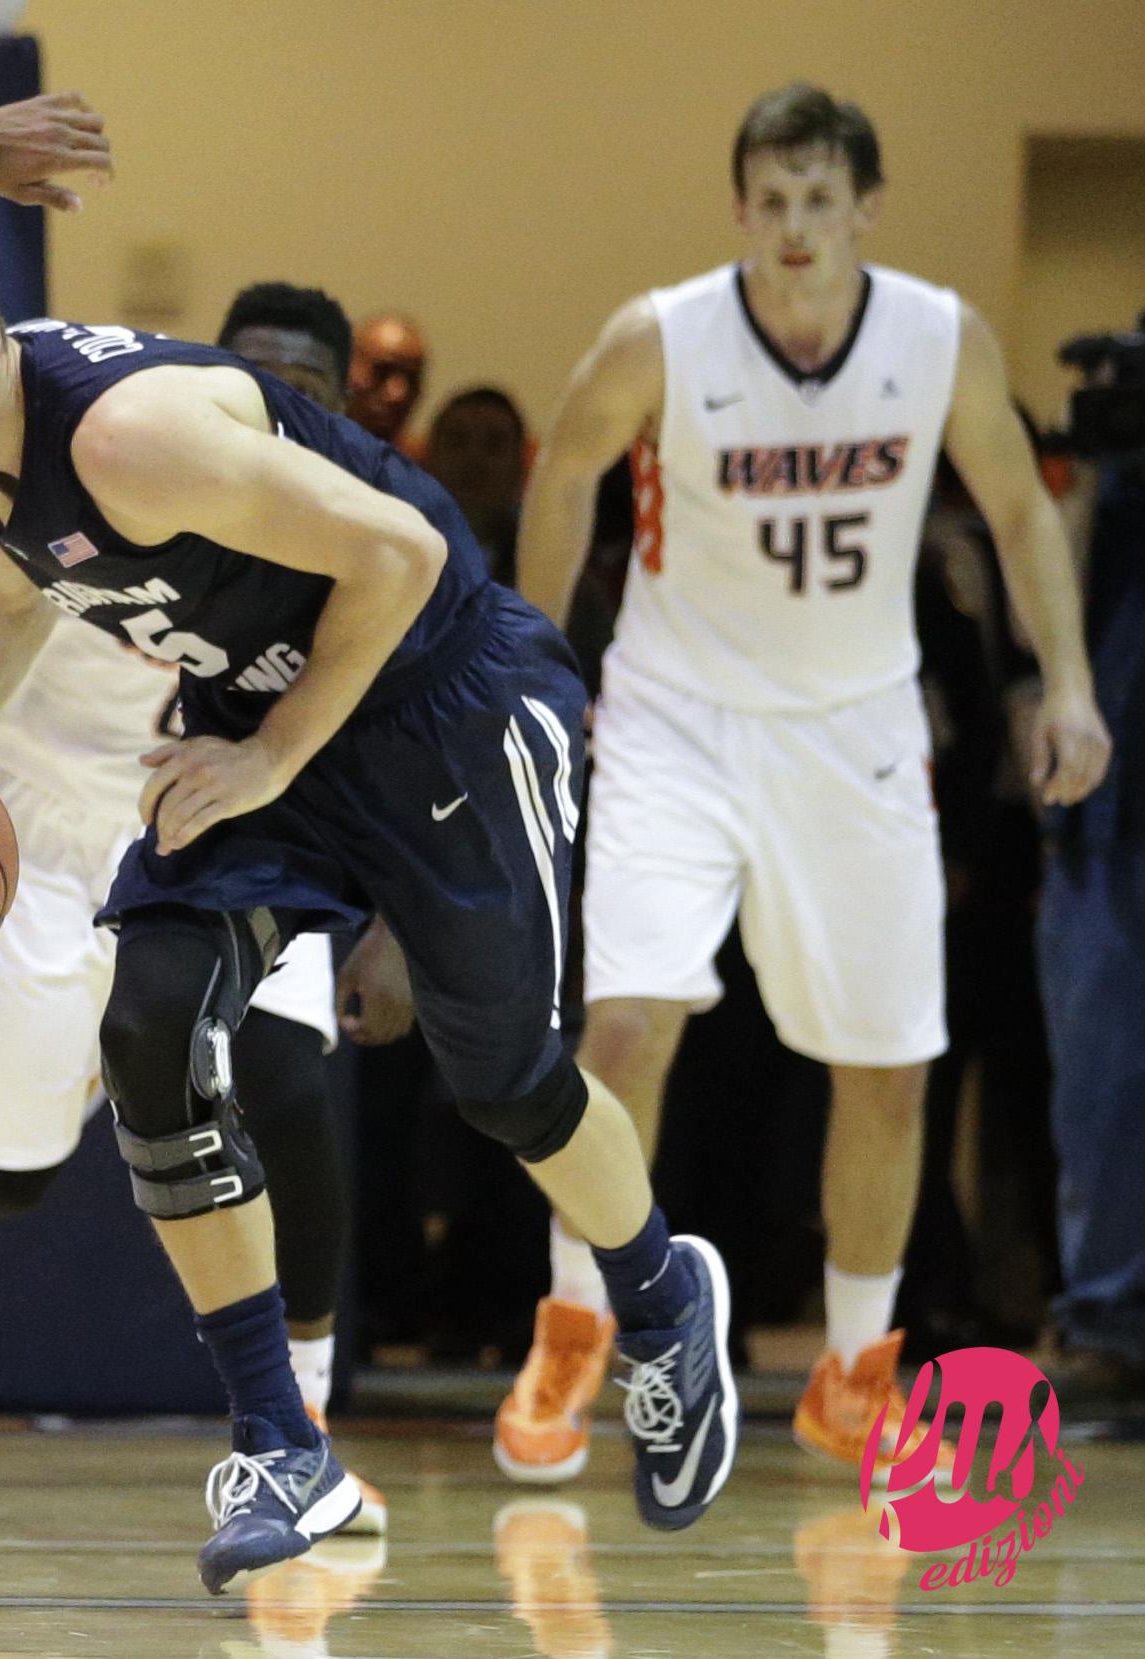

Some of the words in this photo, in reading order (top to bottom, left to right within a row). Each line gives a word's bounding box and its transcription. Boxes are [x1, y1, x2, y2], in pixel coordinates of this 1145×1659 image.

[716, 433, 911, 497] WAVES
[758, 510, 872, 597] 45
[120, 607, 230, 679] 5
